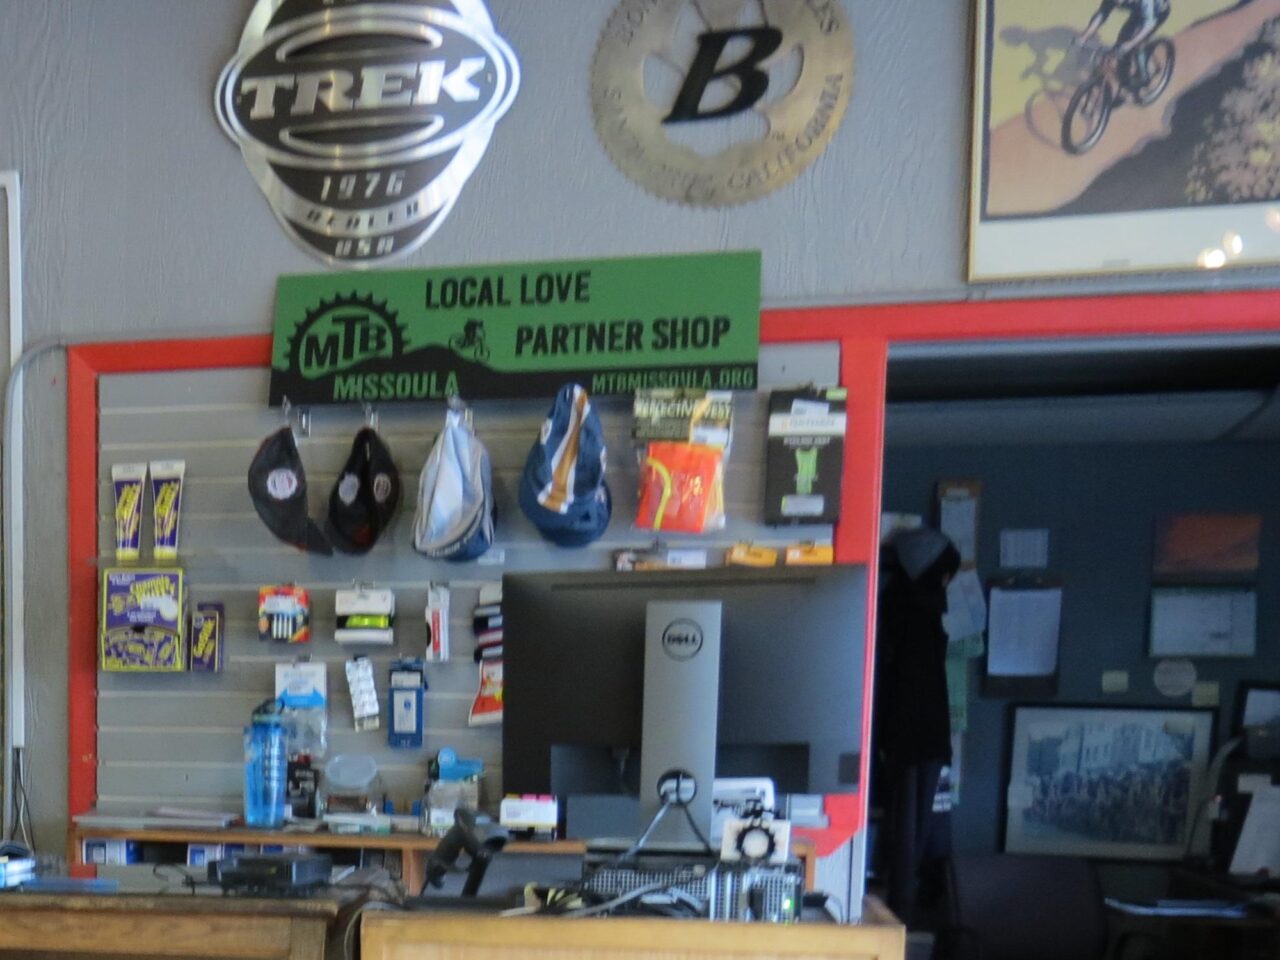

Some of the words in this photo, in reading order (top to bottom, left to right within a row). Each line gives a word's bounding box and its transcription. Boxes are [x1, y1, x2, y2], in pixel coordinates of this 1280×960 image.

[240, 56, 487, 121] TREK
[660, 26, 784, 126] B
[726, 73, 844, 190] CALIFORNIA
[320, 169, 406, 201] 1976
[425, 275, 512, 311] LOCAL
[520, 269, 592, 305] LOVE
[303, 313, 389, 369] MTB
[514, 319, 645, 358] PARTNER
[651, 314, 732, 350] SHOP
[332, 370, 461, 401] MISSOULA
[666, 631, 699, 647] DELL
